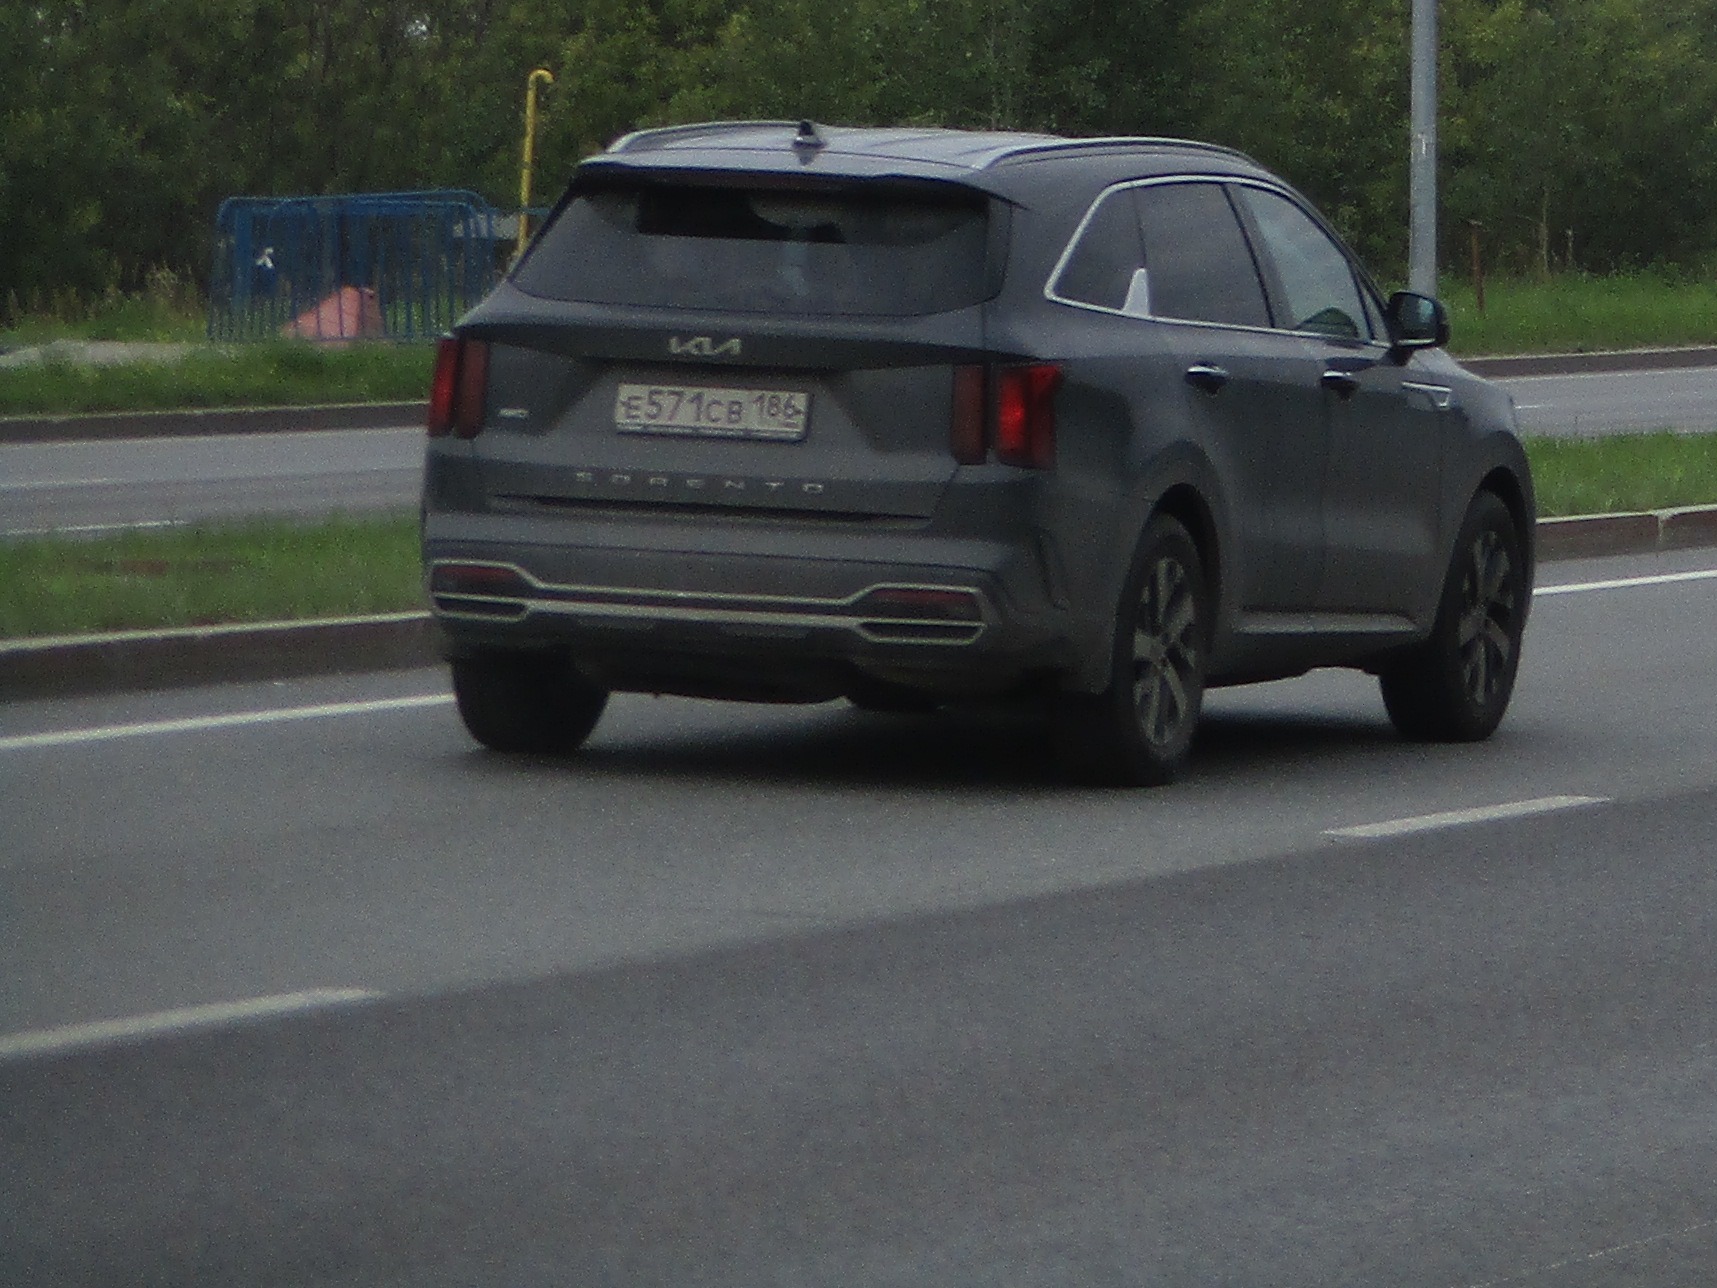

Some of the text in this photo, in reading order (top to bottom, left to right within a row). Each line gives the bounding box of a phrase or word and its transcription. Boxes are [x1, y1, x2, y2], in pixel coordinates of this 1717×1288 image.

[668, 336, 742, 356] KIA
[624, 388, 800, 424] Е571СВ 186
